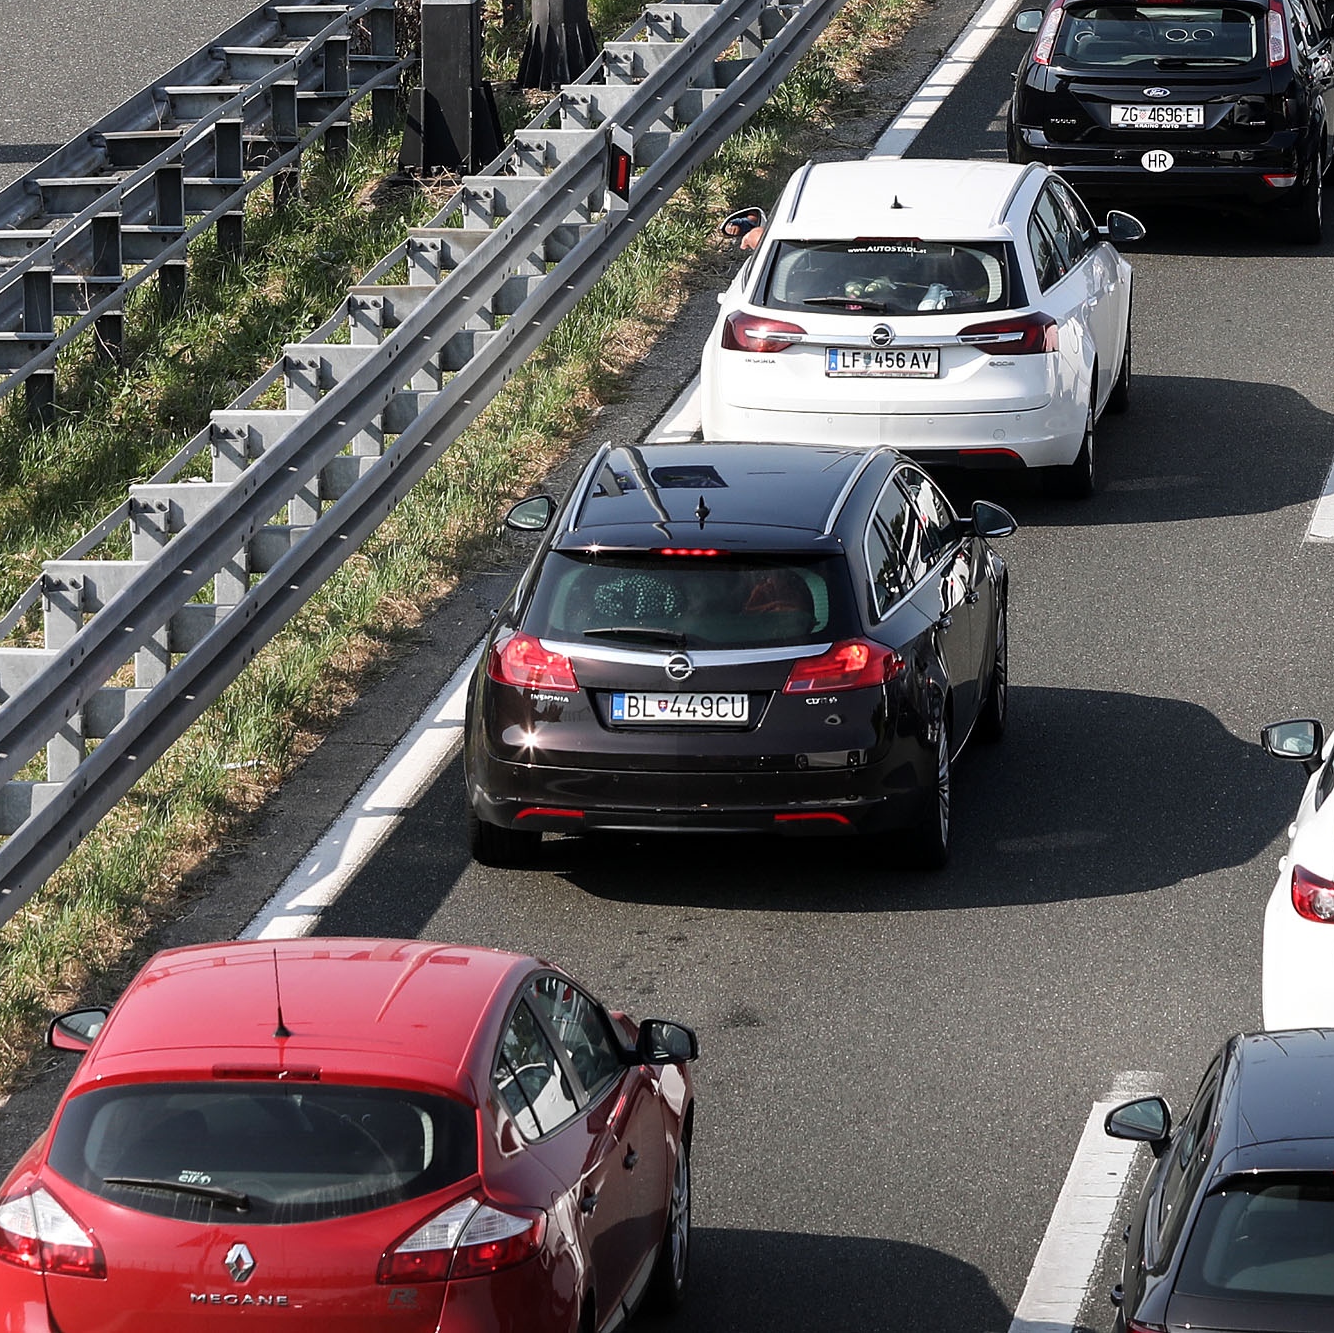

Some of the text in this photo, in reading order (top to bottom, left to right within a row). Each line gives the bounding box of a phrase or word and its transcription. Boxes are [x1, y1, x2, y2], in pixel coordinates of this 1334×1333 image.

[1120, 107, 1138, 123] ZG
[1148, 153, 1167, 169] HR
[841, 351, 861, 369] LF
[874, 351, 906, 369] 456
[910, 351, 932, 369] AV
[628, 695, 655, 719] BL
[670, 695, 745, 719] 449CU
[190, 1292, 289, 1305] MEGANE
